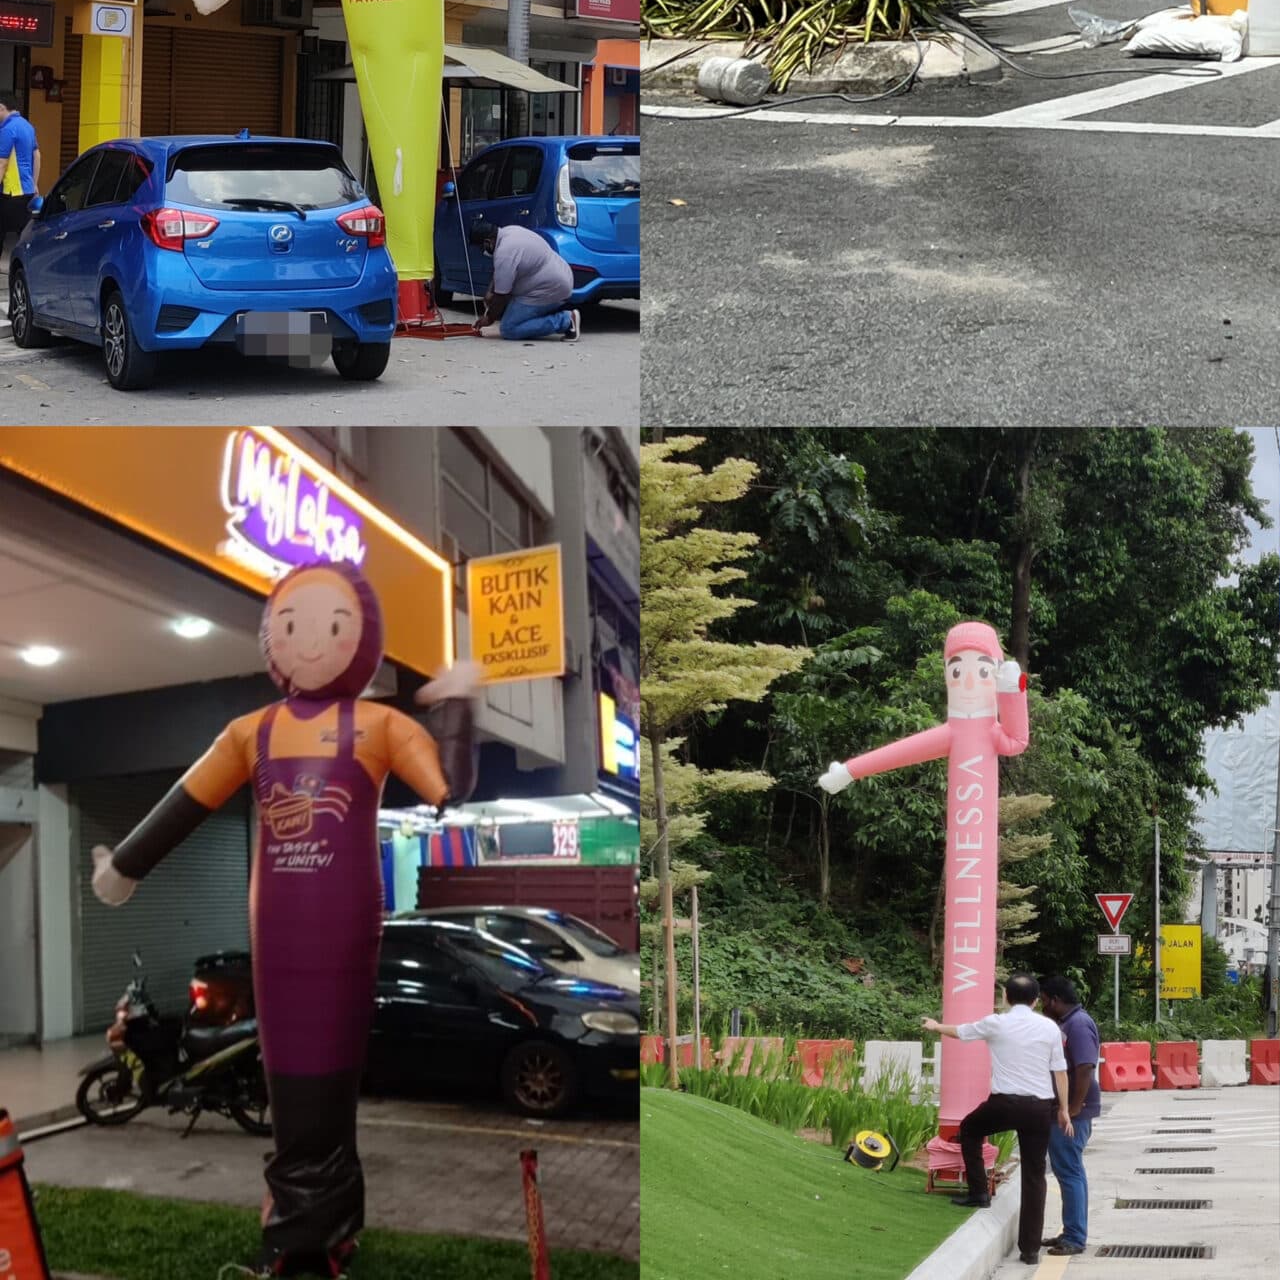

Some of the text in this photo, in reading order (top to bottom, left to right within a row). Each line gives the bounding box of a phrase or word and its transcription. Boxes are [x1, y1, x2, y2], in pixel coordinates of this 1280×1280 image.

[480, 565, 549, 596] BUTIK
[489, 590, 542, 616] KAIN
[490, 624, 543, 650] LACE
[482, 643, 551, 665] EKSKLUSIF
[1168, 939, 1194, 948] JALAN
